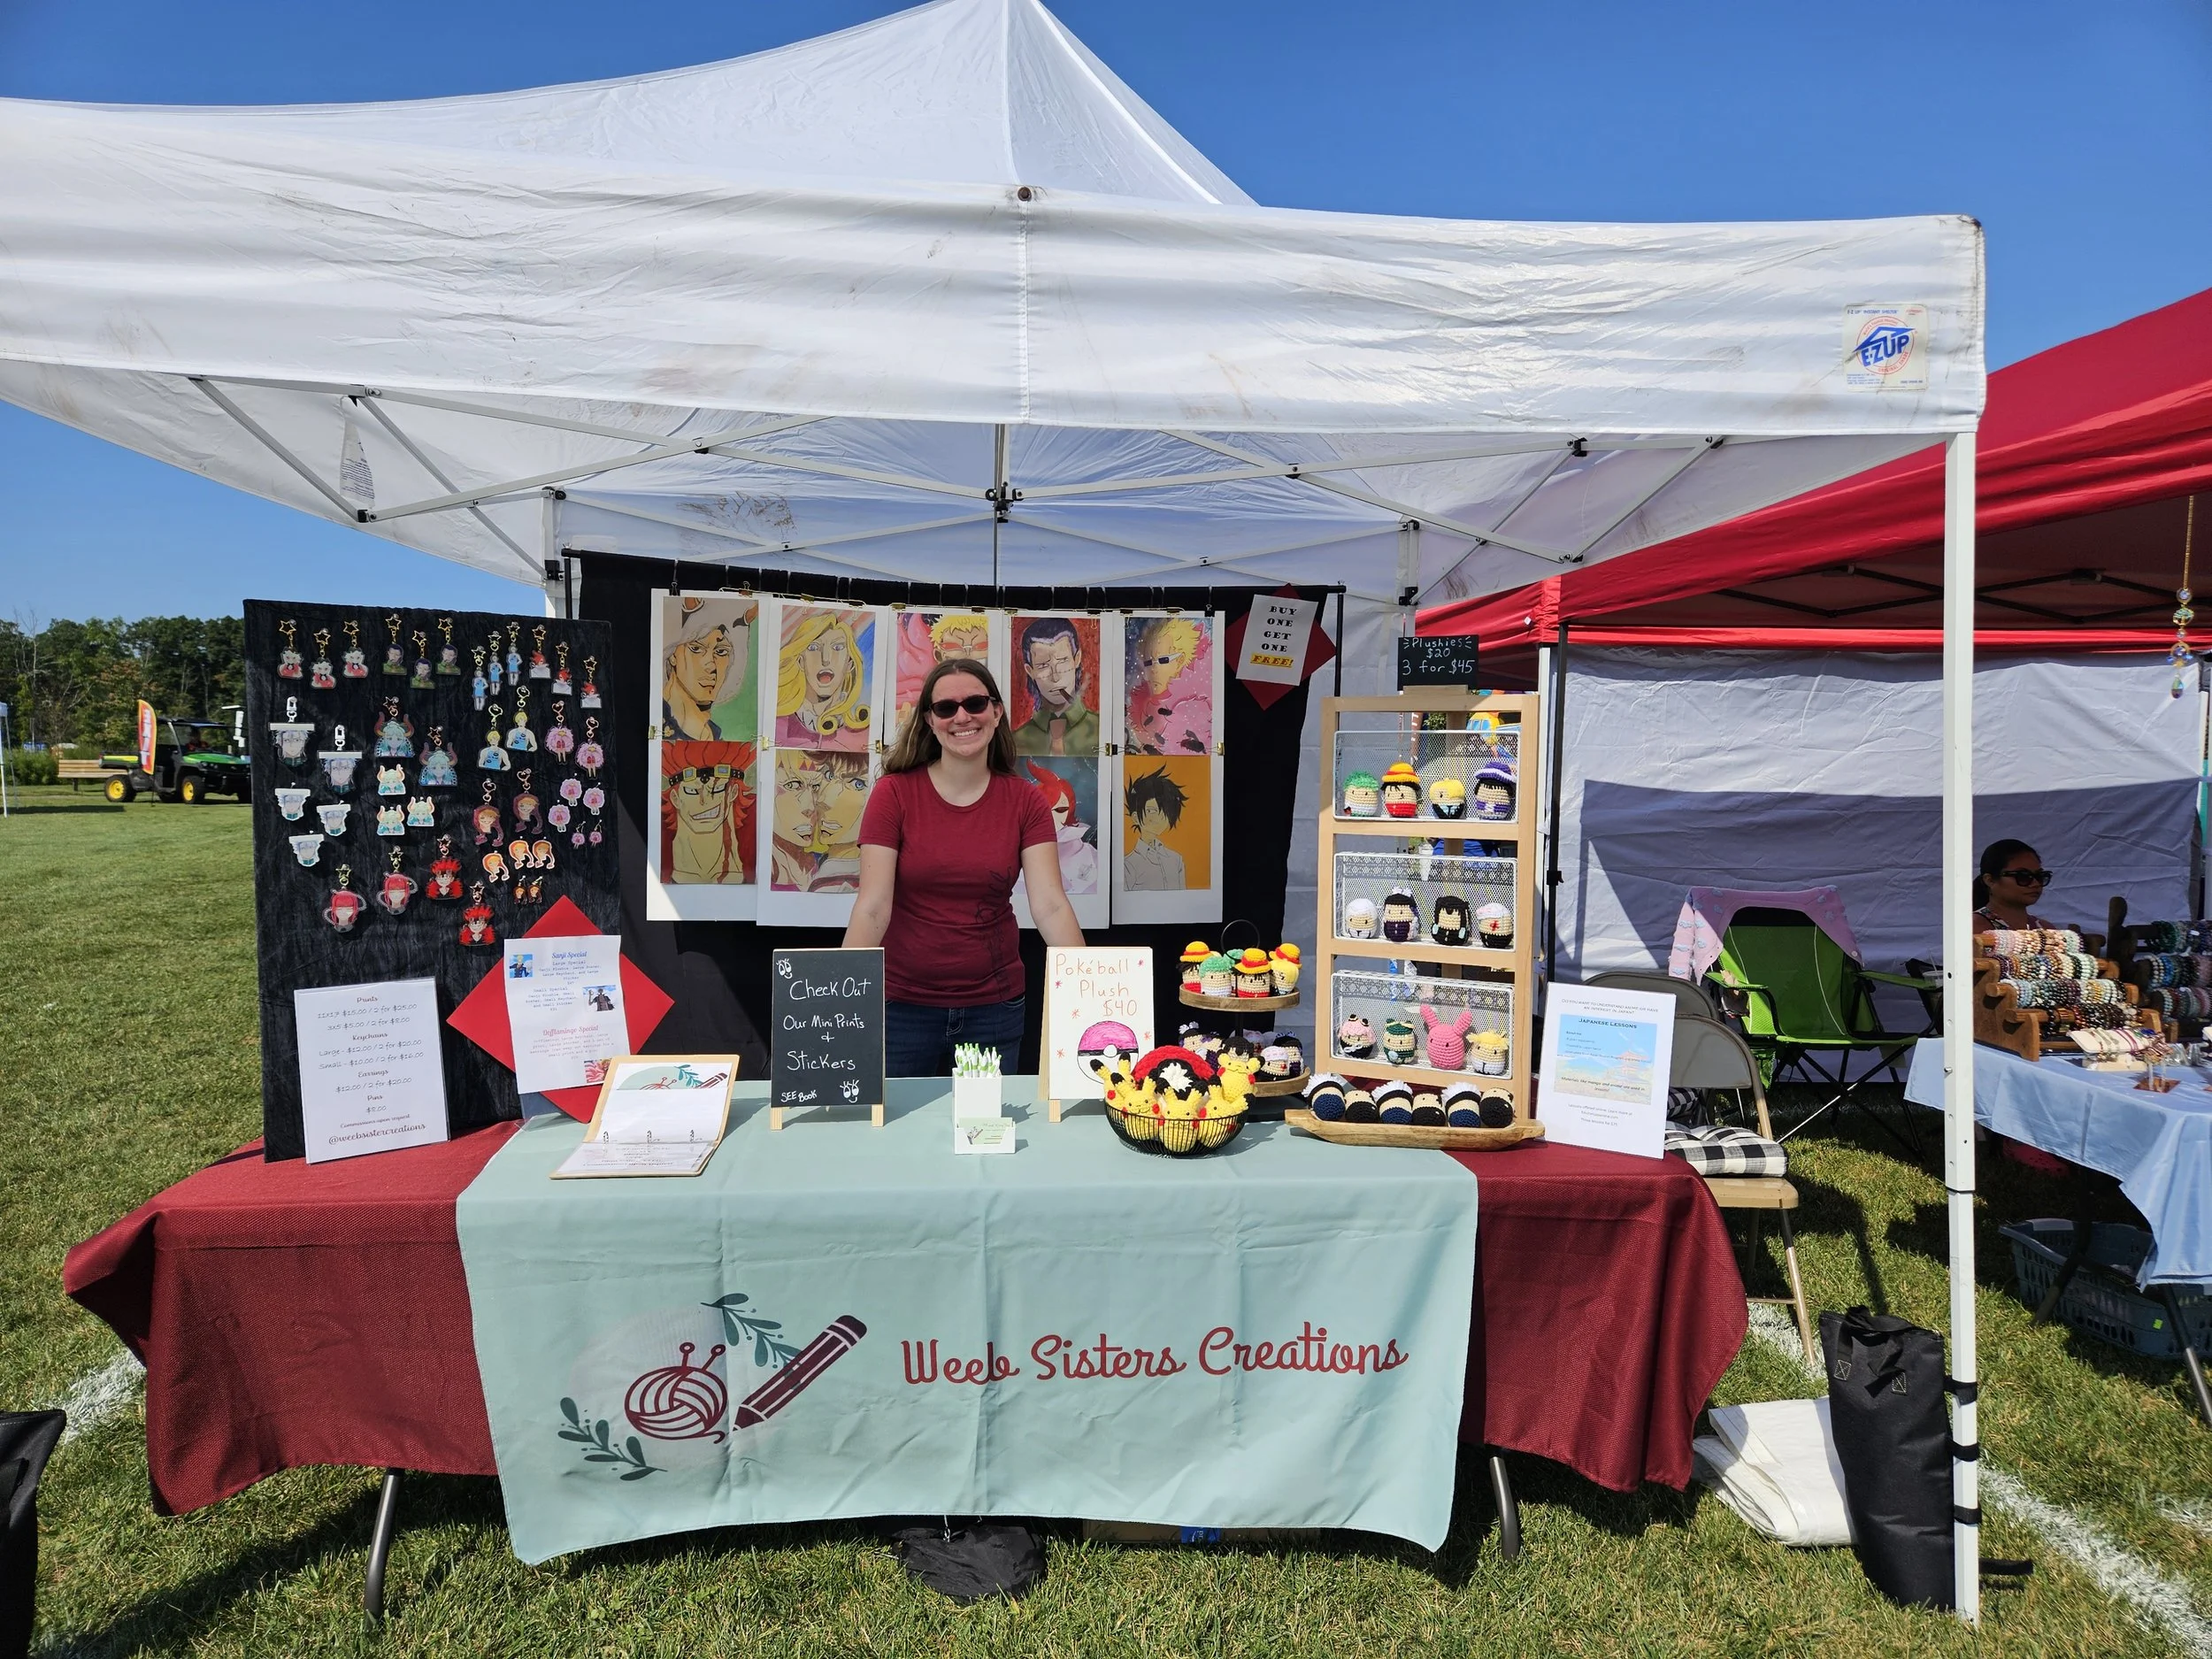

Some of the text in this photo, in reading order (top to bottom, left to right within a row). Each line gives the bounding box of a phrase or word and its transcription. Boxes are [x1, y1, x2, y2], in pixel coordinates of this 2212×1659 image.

[1269, 605, 1297, 616] BUY
[1267, 618, 1294, 627] ONE
[1263, 631, 1291, 641] GET
[1261, 643, 1288, 652] ONE
[1412, 637, 1463, 648] Plushies
[1426, 648, 1451, 659] $20
[1252, 655, 1294, 666] FREE!
[1402, 658, 1476, 676] 3 for $45
[567, 950, 588, 959] Special
[842, 977, 872, 998] Out
[1079, 979, 1130, 998] Plush
[380, 1005, 390, 1014] for
[1102, 999, 1138, 1017] $40
[782, 1012, 865, 1031] Our Mini Prints
[579, 1025, 599, 1033] Special
[352, 1032, 388, 1041] Keychains
[388, 1055, 398, 1064] for
[357, 1069, 389, 1078] Earrings
[375, 1079, 386, 1088] for
[780, 1091, 797, 1103] SEE
[901, 1320, 1409, 1386] Weeb Sisters Creations
